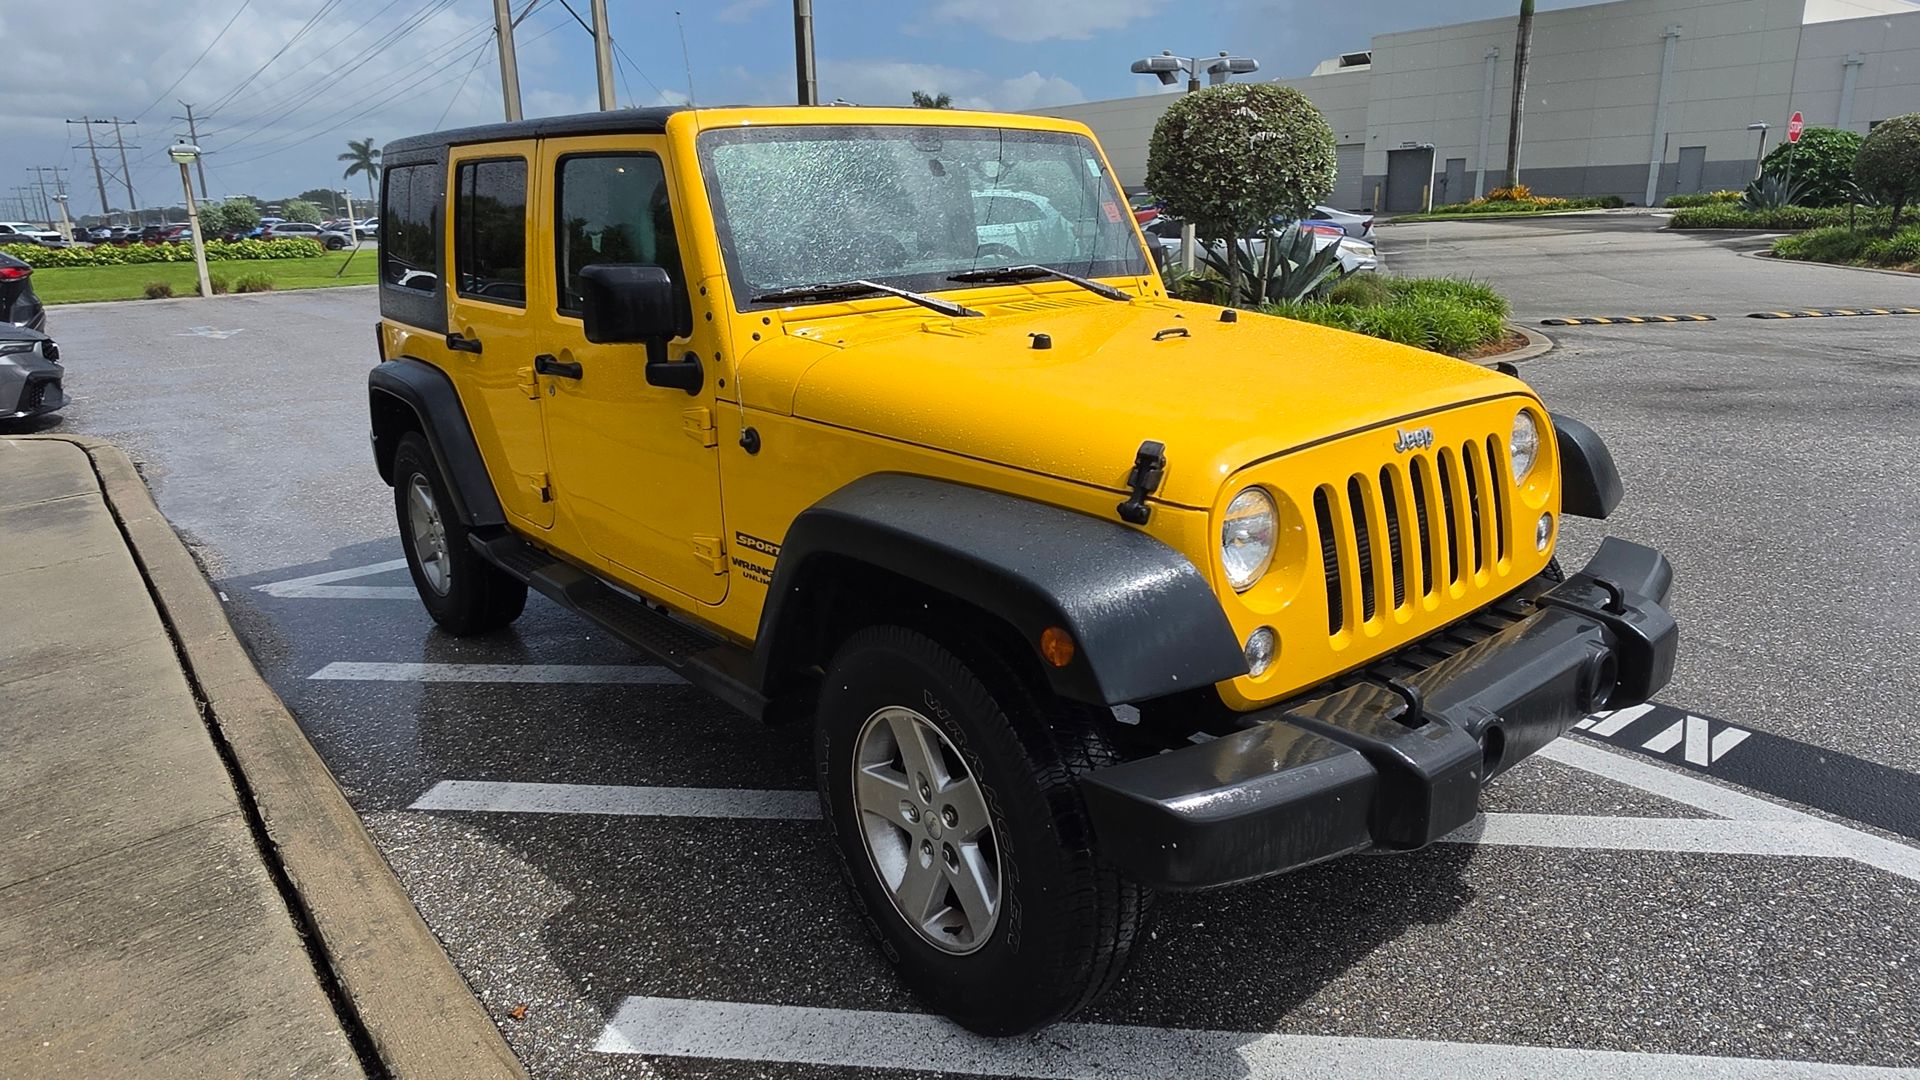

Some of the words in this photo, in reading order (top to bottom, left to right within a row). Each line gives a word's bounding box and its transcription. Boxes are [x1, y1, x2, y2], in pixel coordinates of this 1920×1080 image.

[1394, 428, 1433, 453] Jeep
[737, 534, 781, 556] SPORT
[732, 556, 773, 577] WRANG
[923, 688, 1024, 954] WRANGLER
